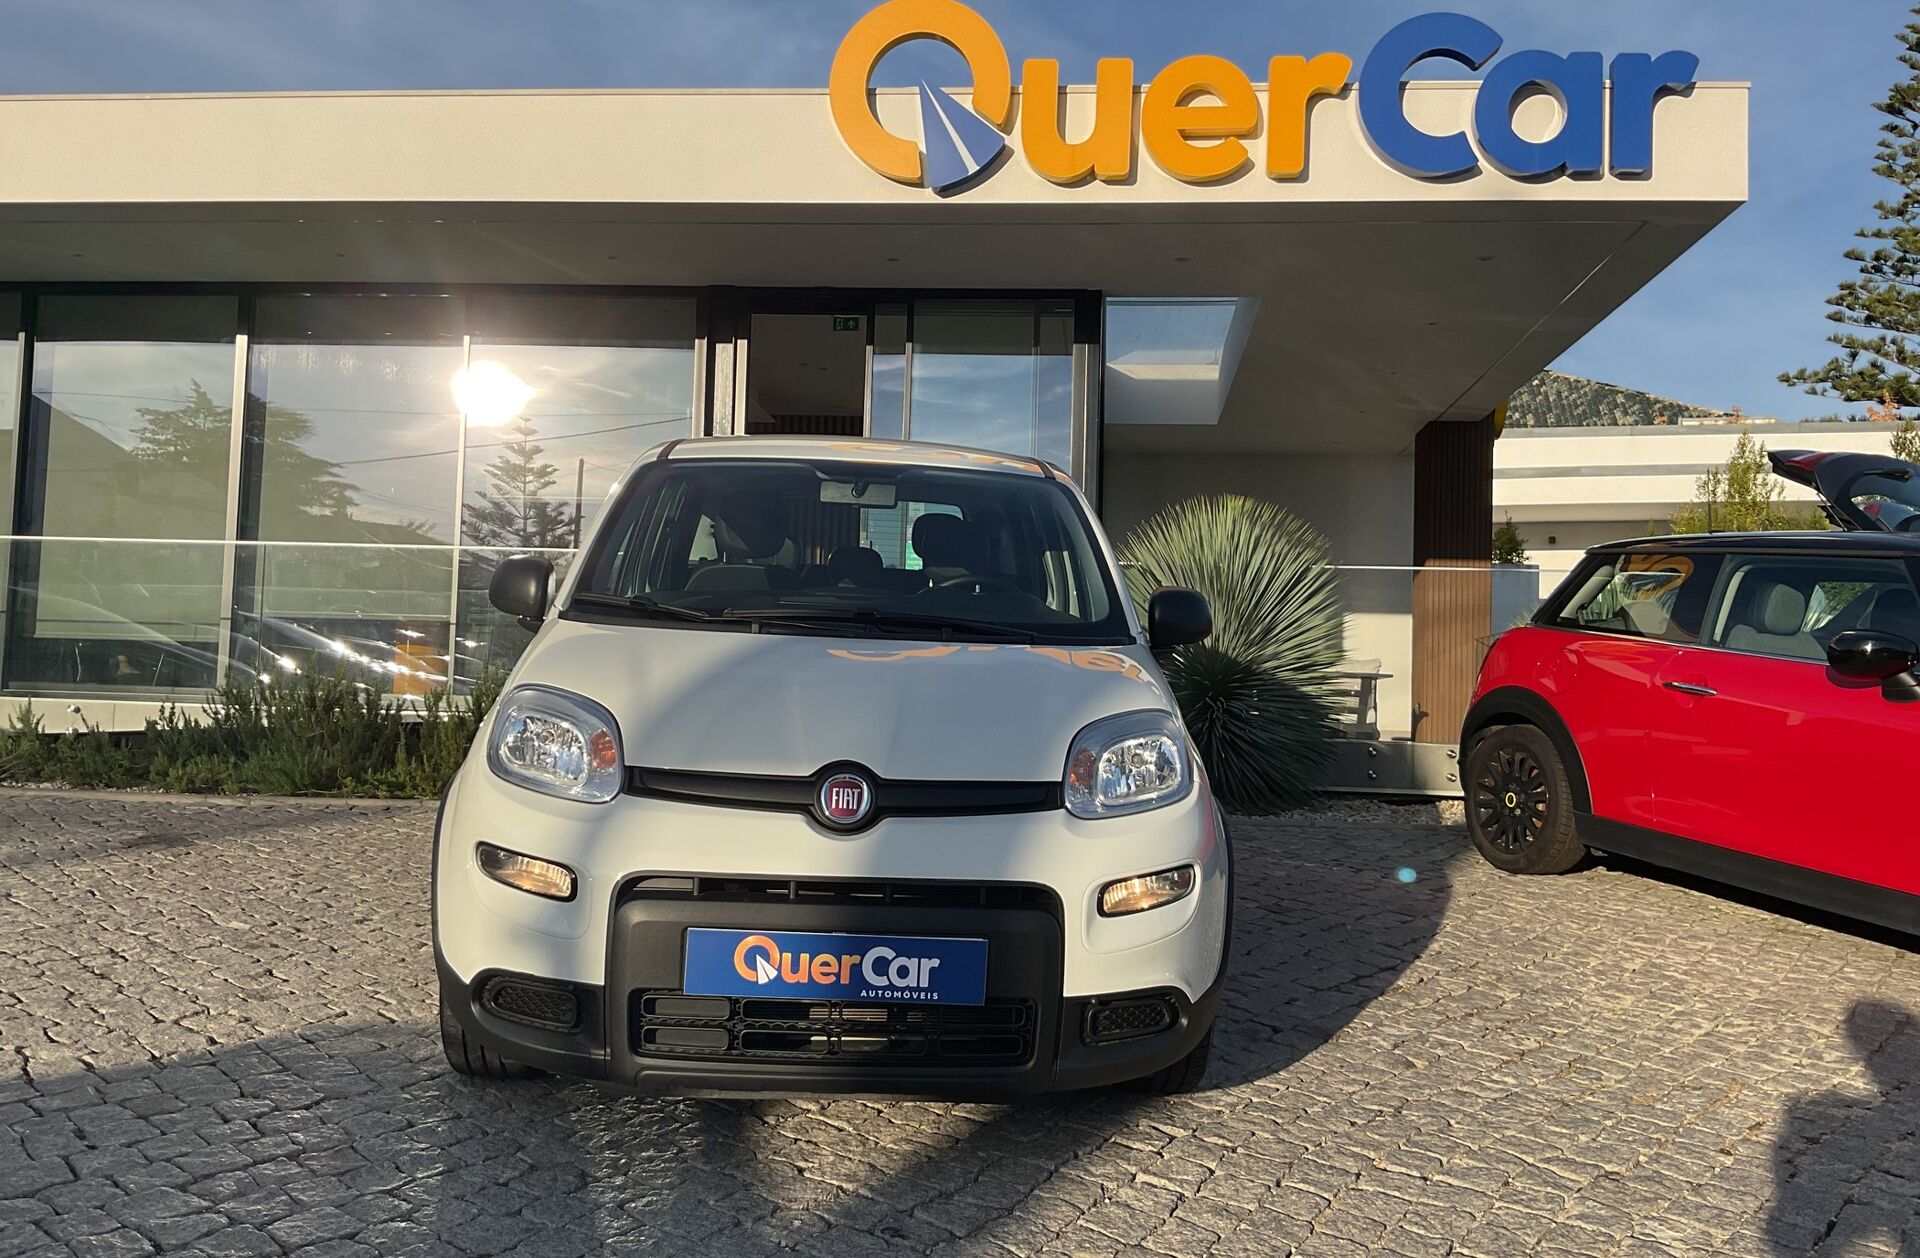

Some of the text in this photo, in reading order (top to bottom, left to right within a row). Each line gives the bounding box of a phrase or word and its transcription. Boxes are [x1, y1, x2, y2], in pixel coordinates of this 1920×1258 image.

[829, 0, 1699, 190] QuerCar
[832, 787, 861, 810] FIAT
[734, 935, 940, 988] QuerCar
[860, 989, 939, 1000] AUTOMÓVEIS
